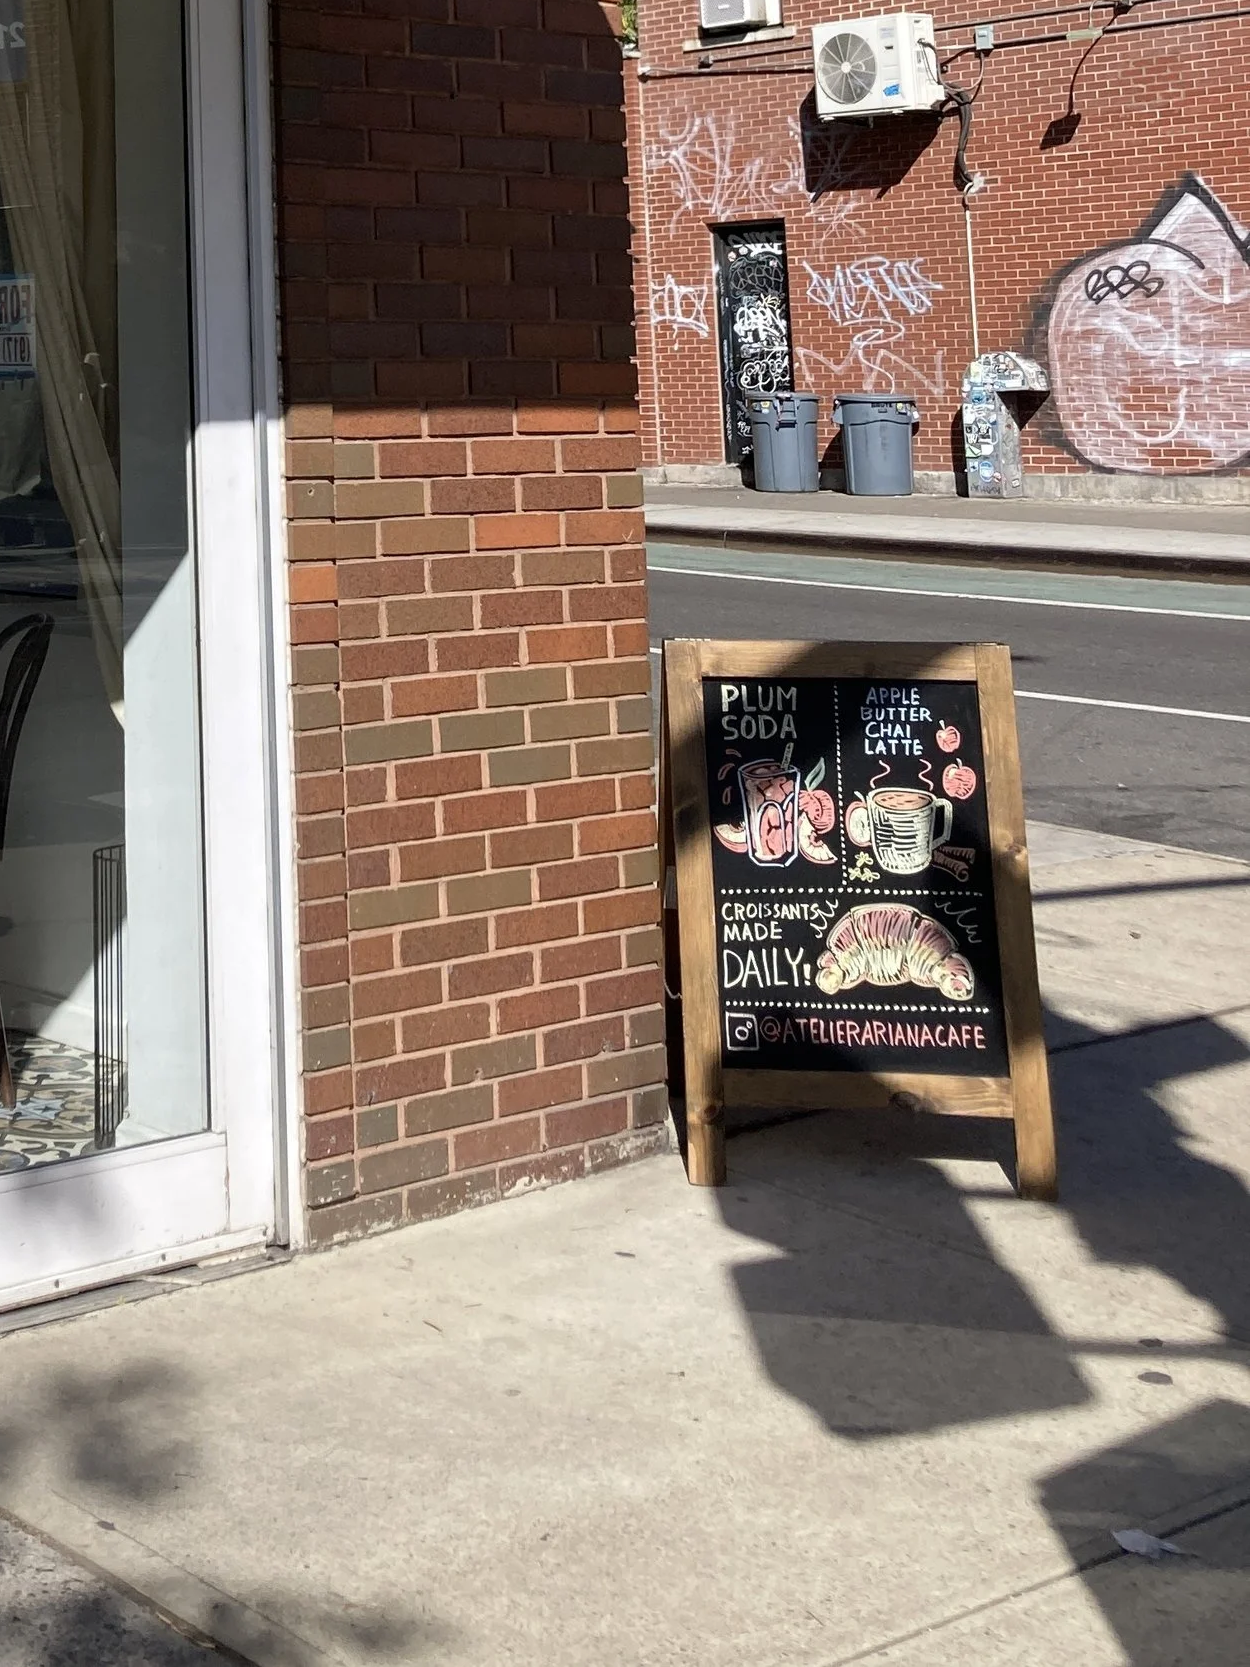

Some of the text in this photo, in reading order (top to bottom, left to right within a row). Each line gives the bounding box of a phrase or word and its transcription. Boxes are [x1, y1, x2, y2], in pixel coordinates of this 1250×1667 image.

[721, 684, 797, 711] PLUM
[865, 687, 920, 705] APPLE
[861, 707, 932, 722] BUTTER
[722, 714, 797, 740] SODA
[865, 721, 911, 739] CHAI
[864, 739, 923, 756] LATTE
[721, 902, 820, 921] CROISSANTS
[723, 921, 782, 942] MADE
[723, 947, 811, 988] DAILY!
[760, 1016, 986, 1049] @ATELIERARIANACAFE
